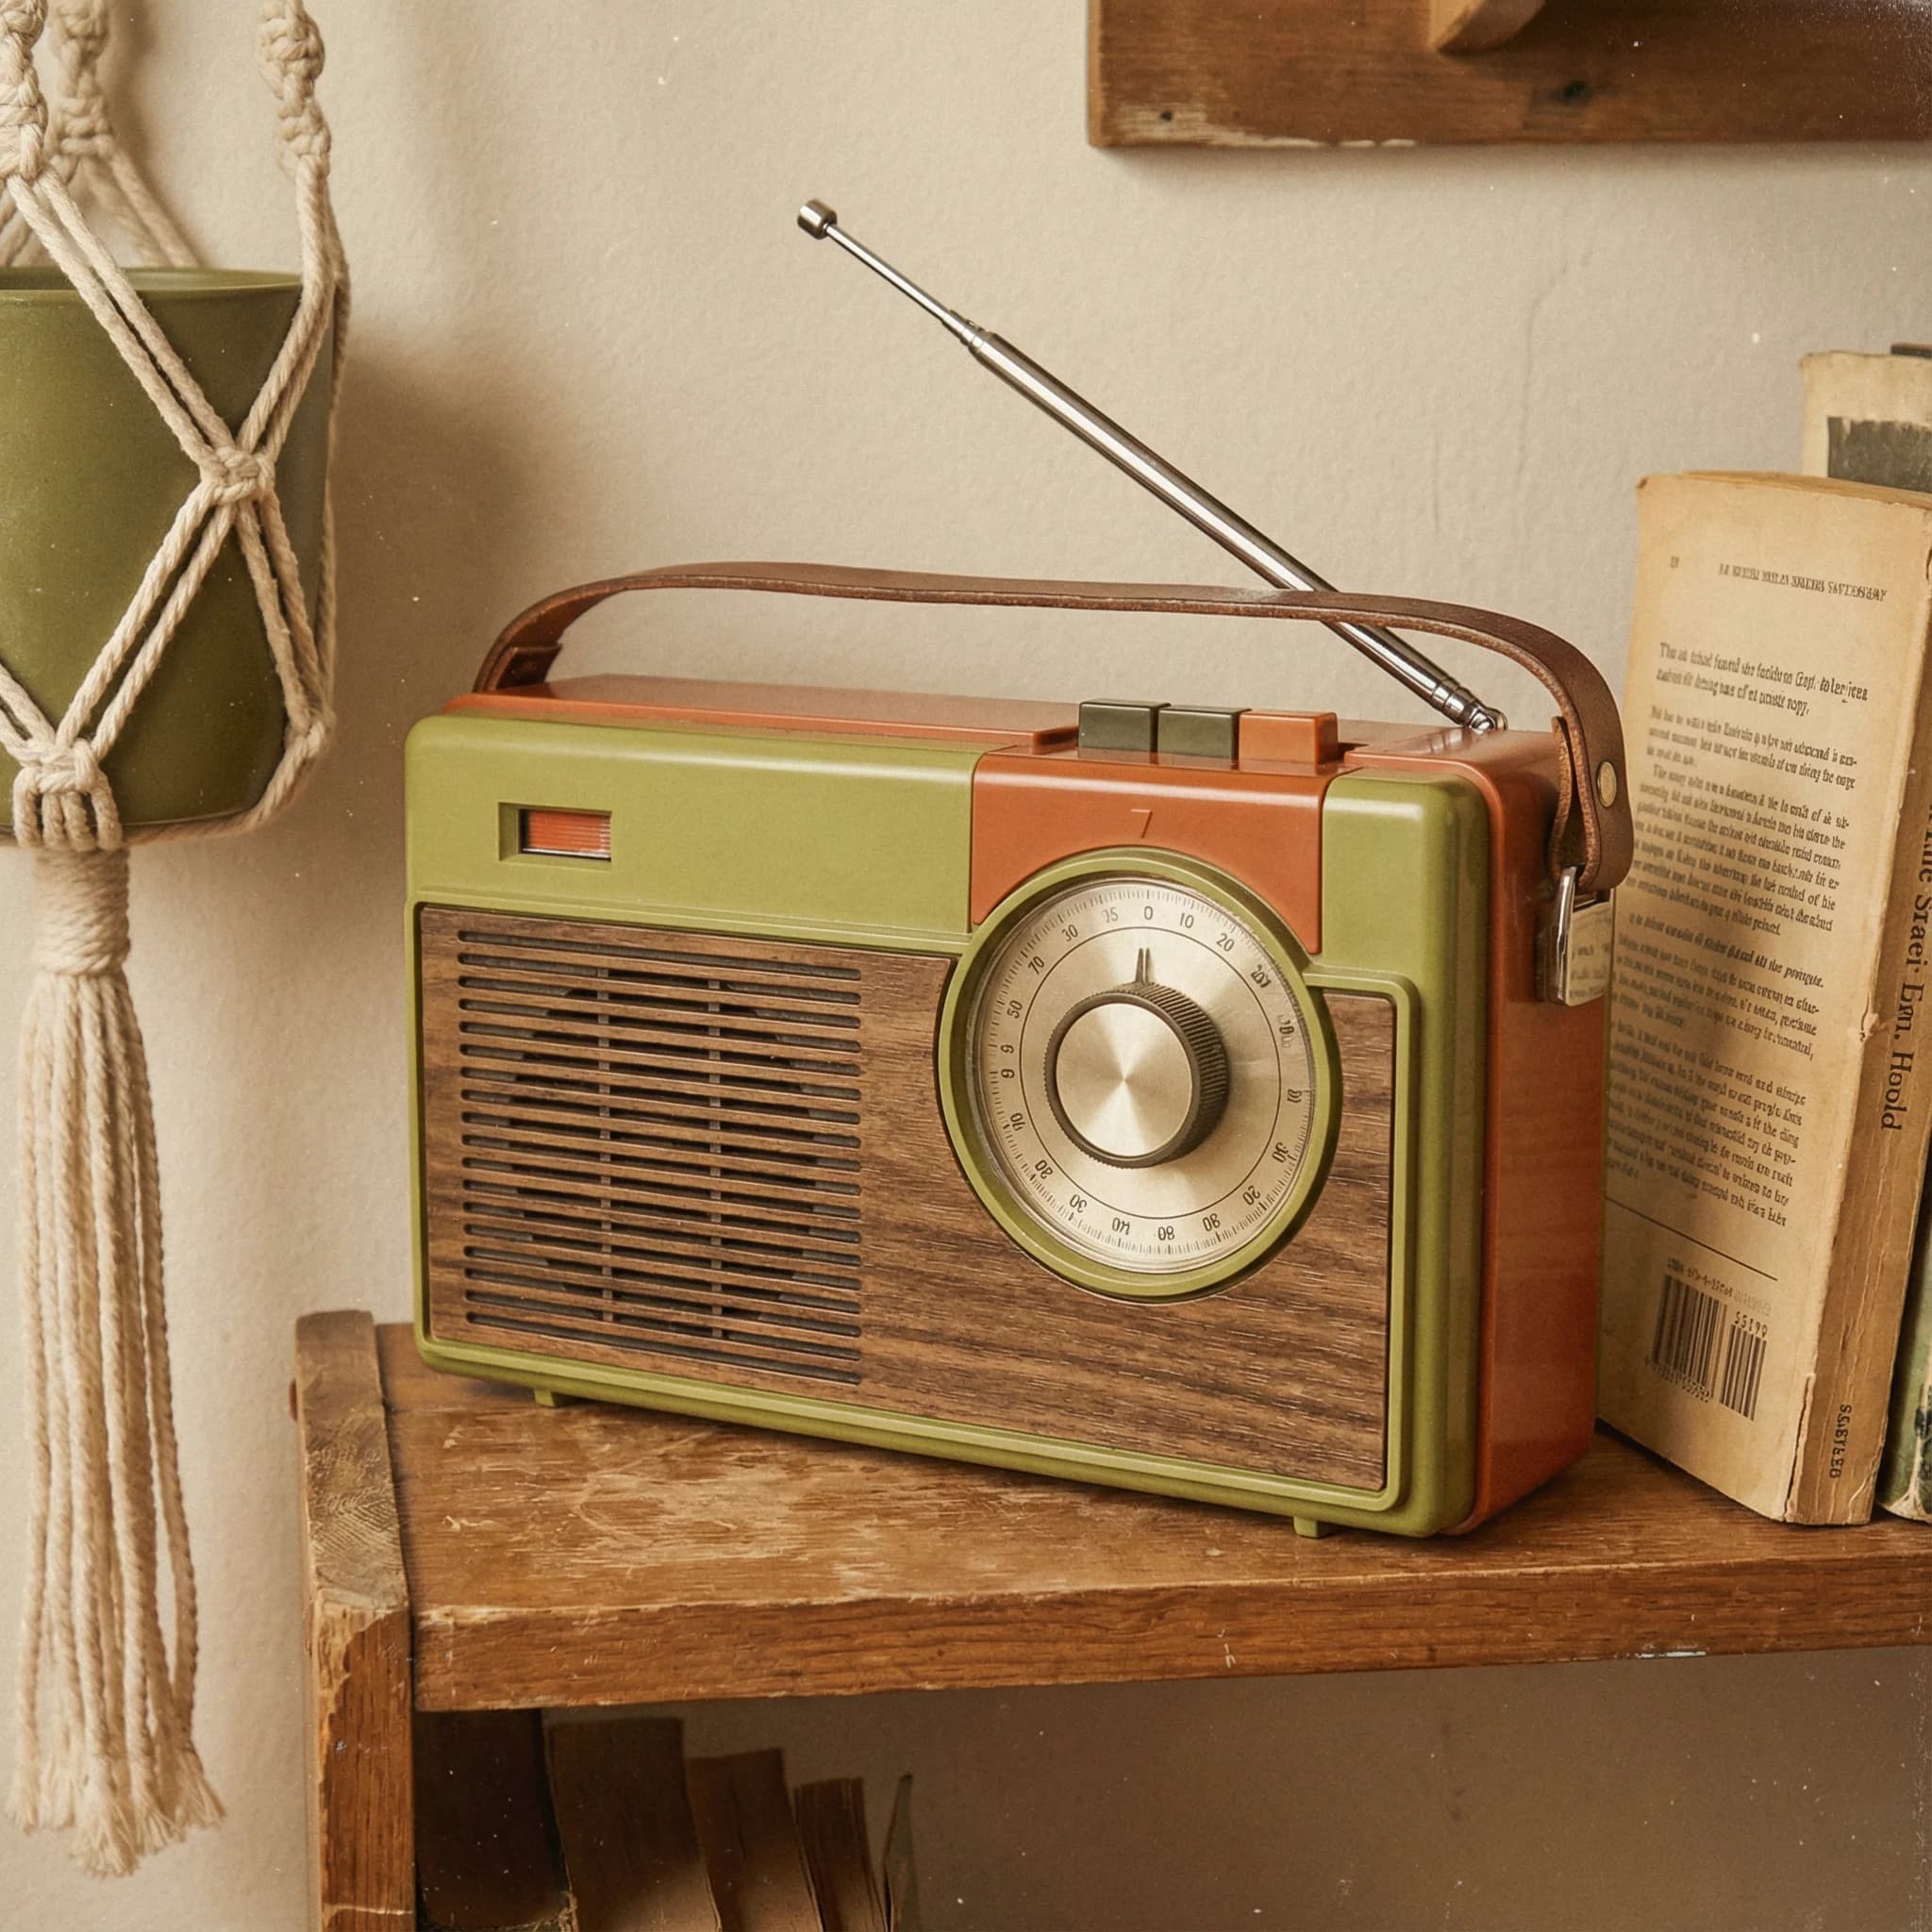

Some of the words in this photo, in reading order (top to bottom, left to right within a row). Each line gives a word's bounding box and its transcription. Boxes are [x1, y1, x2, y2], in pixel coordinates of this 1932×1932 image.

[1143, 906, 1154, 921] 0
[1179, 912, 1194, 929] 10
[1061, 924, 1079, 942] 30
[1217, 932, 1235, 952] 20
[1028, 956, 1046, 974] 70
[1007, 1000, 1023, 1020] 50
[1070, 1193, 1089, 1213] 30
[1242, 1184, 1260, 1206] 20
